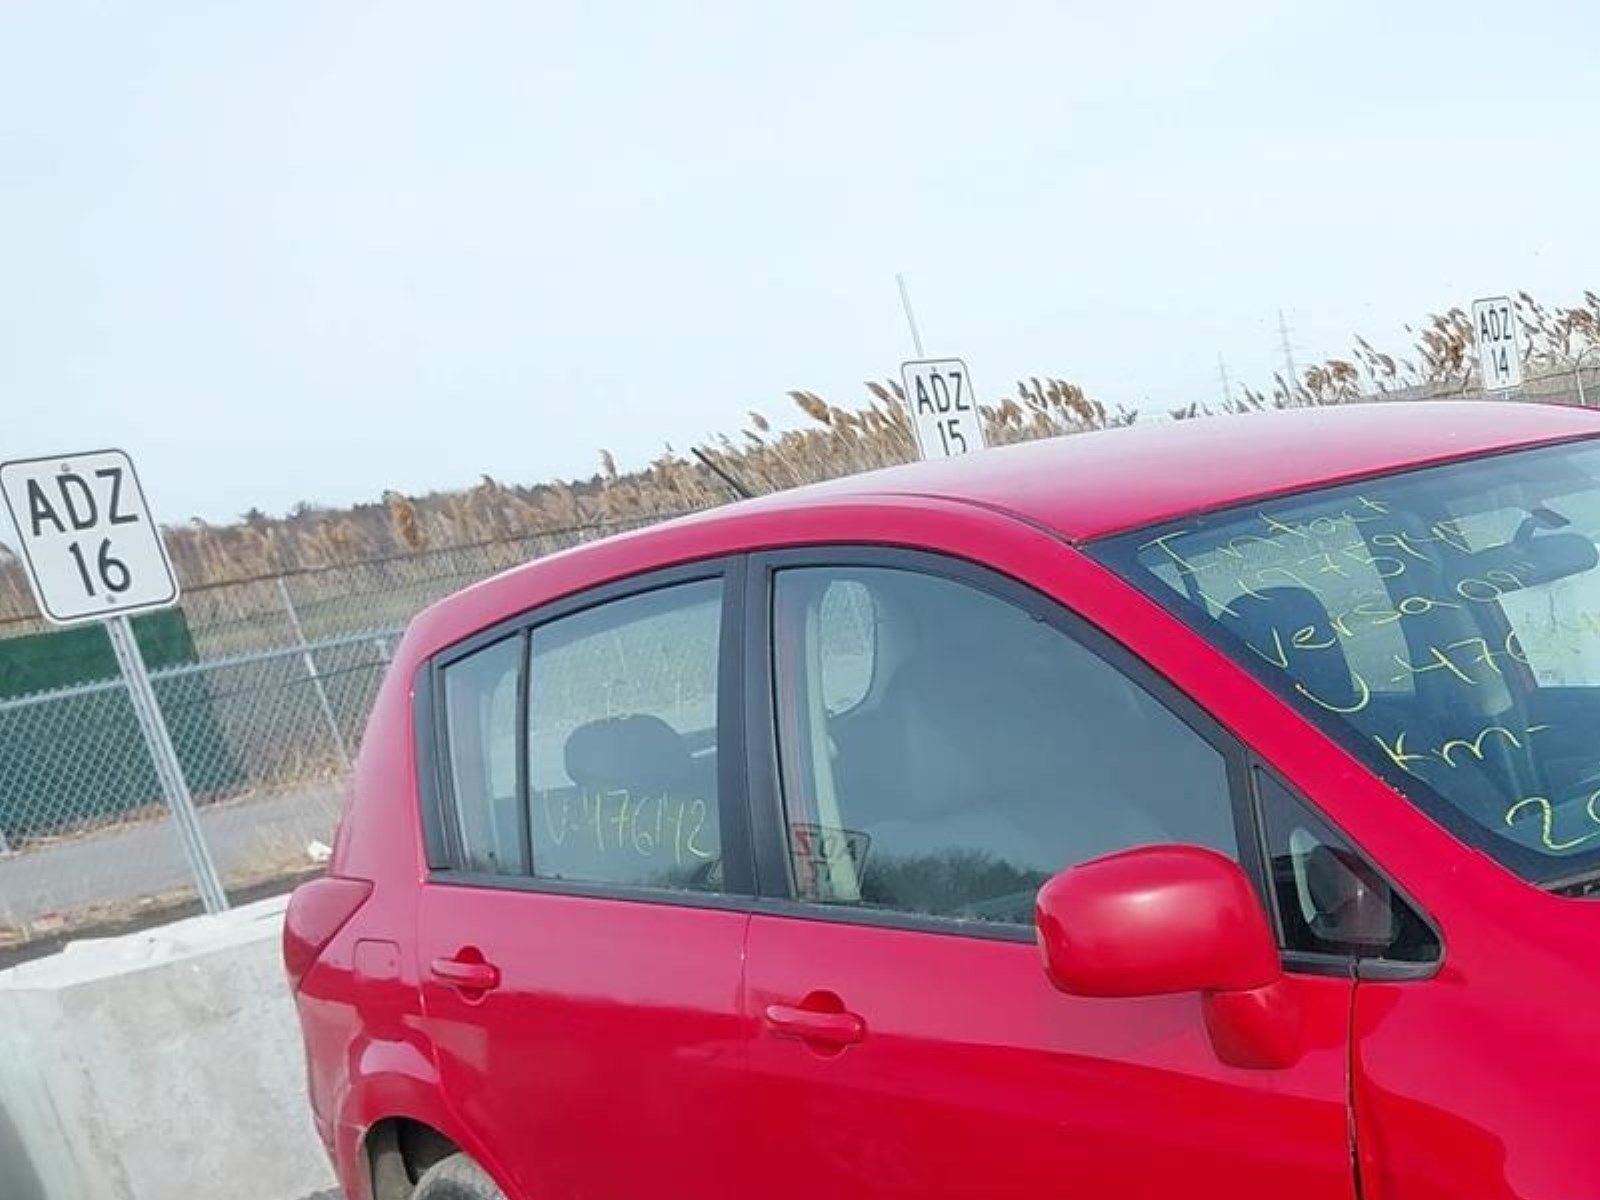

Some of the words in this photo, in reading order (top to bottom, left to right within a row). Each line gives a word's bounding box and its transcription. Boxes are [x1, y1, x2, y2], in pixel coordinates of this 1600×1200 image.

[1480, 306, 1512, 342] ADZ
[1491, 347, 1510, 381] 14
[915, 372, 970, 415] ADZ
[937, 419, 967, 456] 15
[27, 468, 139, 536] ADZ
[69, 538, 131, 596] 16
